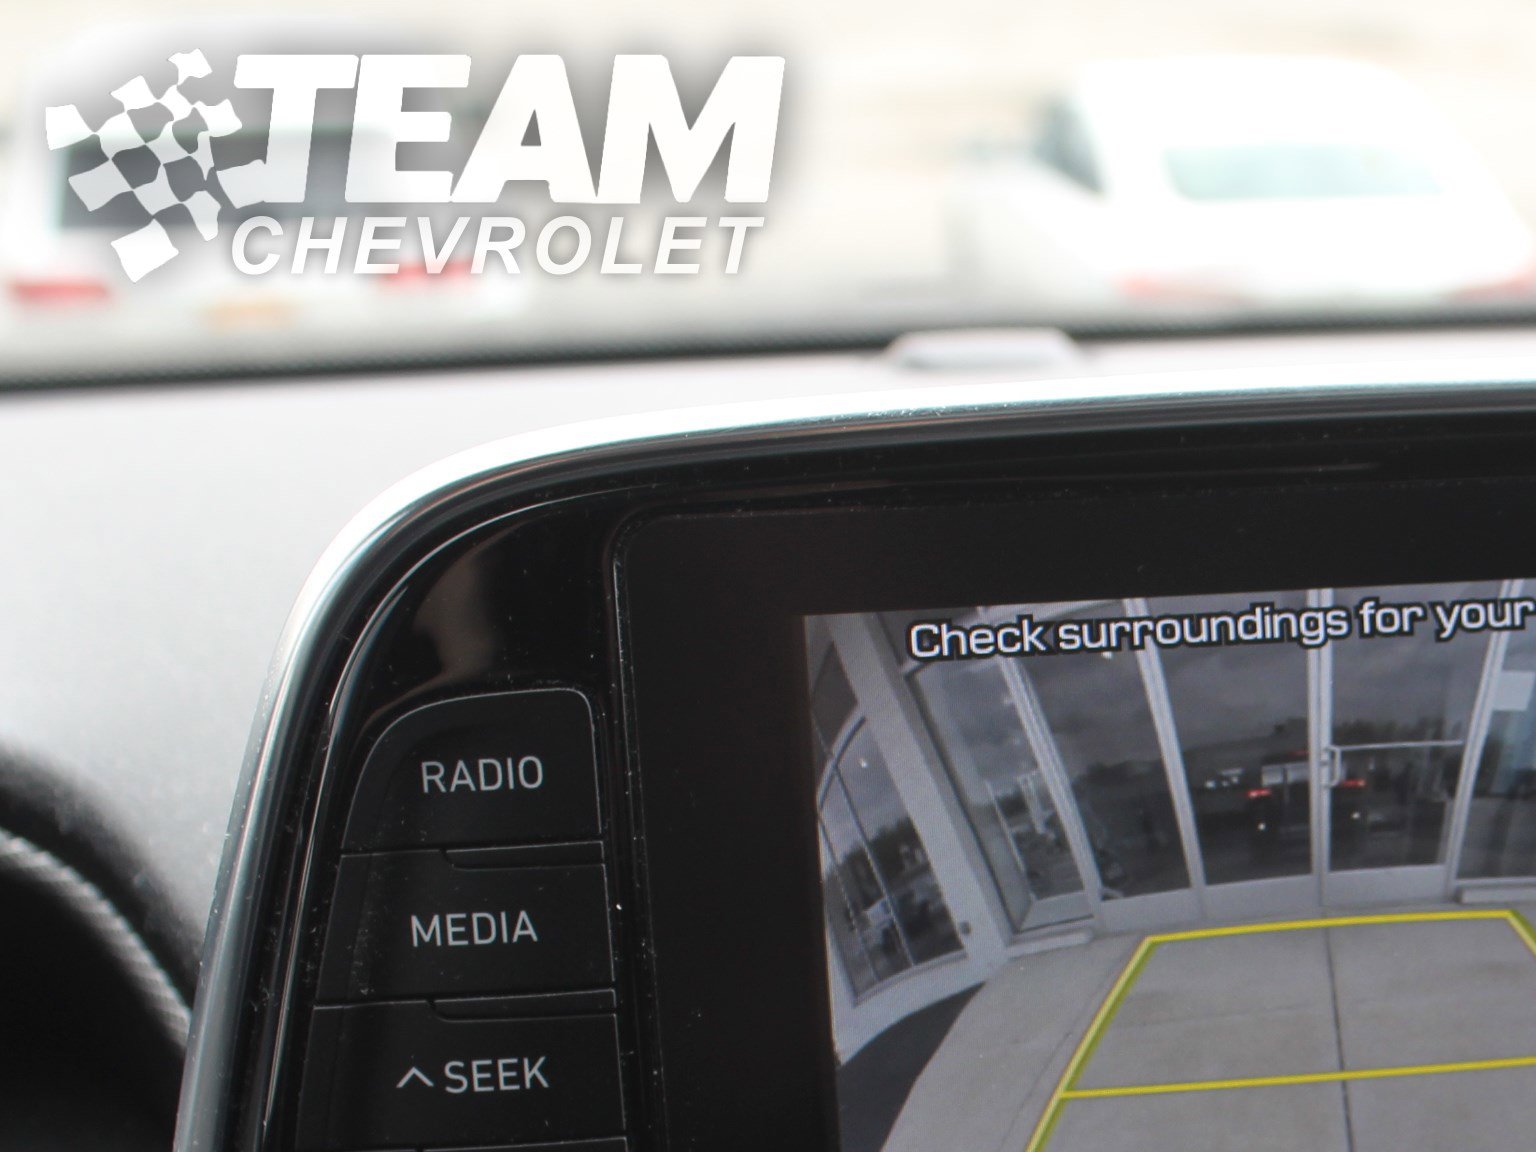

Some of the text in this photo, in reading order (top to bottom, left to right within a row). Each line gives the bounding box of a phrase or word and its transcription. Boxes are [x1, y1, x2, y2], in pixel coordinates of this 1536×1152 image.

[909, 617, 1047, 658] Check
[1057, 606, 1349, 650] surroundings
[1359, 600, 1424, 635] for
[1434, 601, 1535, 640] your
[420, 755, 544, 794] RADIO
[409, 910, 539, 948] MEDIA
[443, 1055, 550, 1094] SEEK
